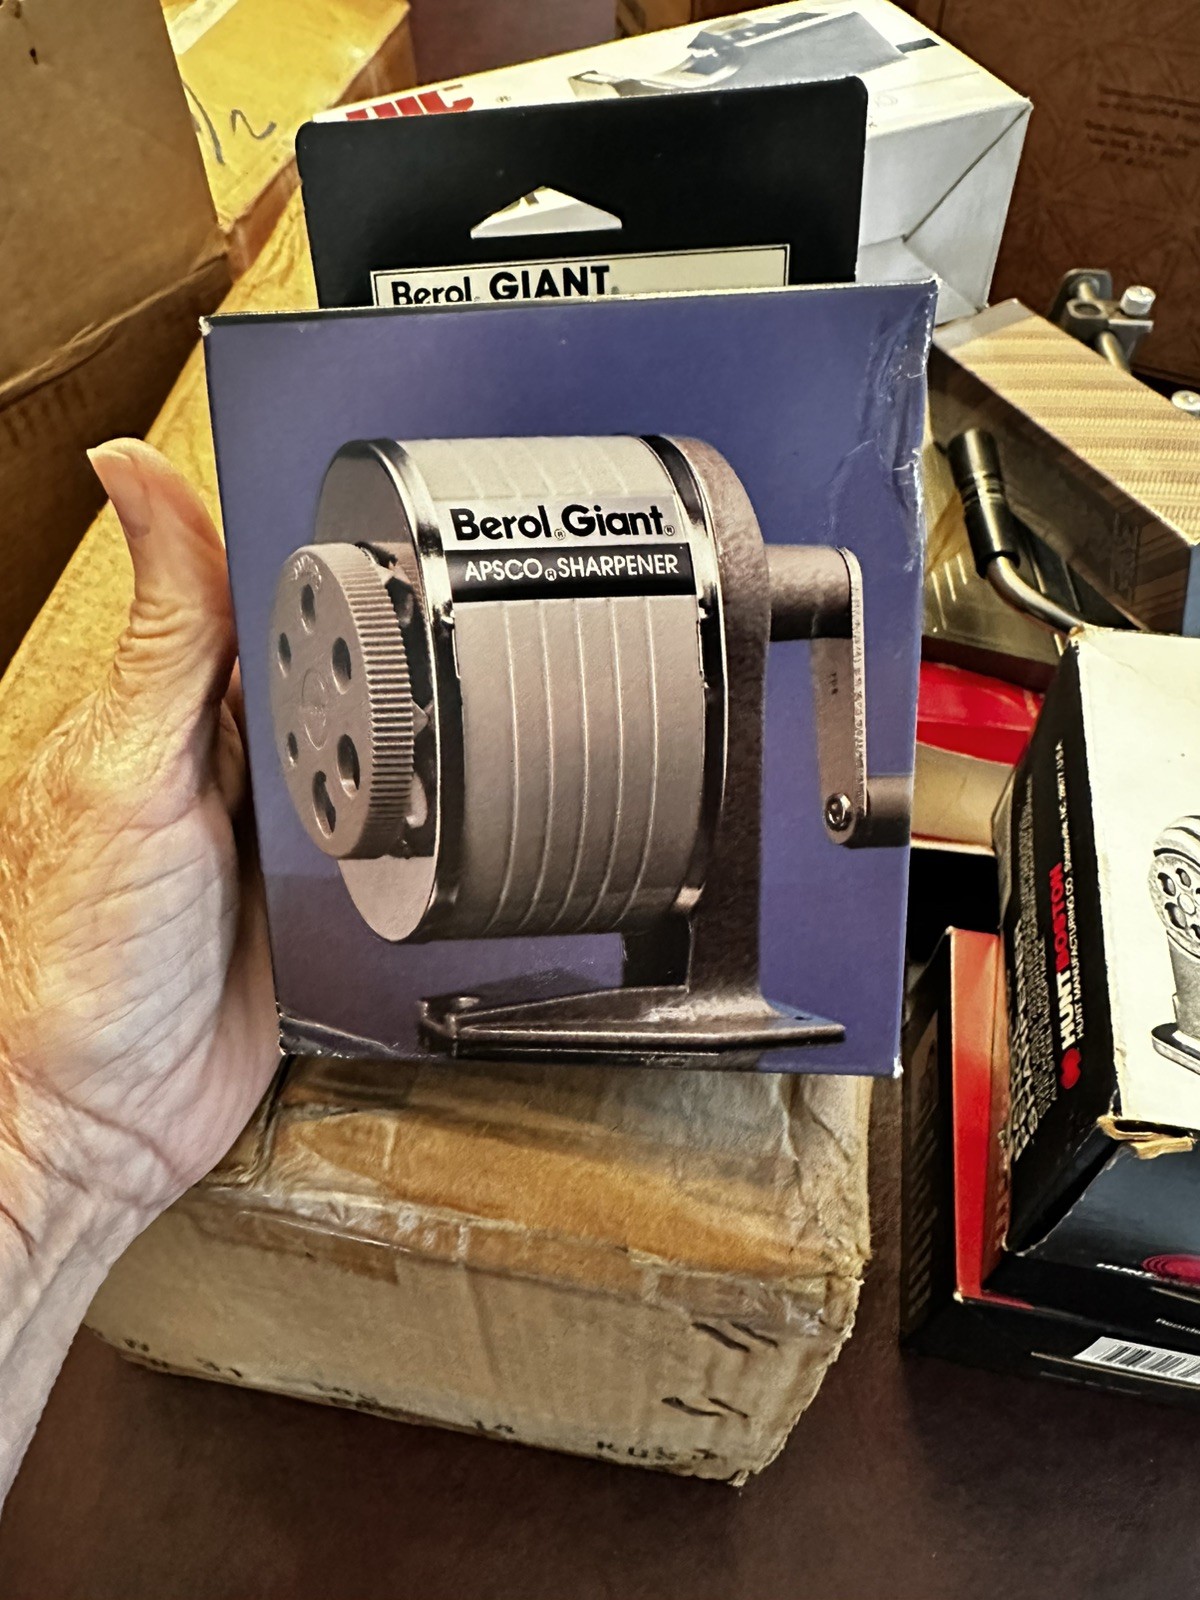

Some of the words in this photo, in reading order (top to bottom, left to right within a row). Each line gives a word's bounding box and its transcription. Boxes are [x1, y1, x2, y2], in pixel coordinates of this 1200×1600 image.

[391, 276, 473, 305] Berol
[489, 265, 610, 300] GIANT
[449, 504, 552, 541] Berol
[561, 503, 664, 537] Giant
[464, 557, 543, 582] APSCO
[557, 553, 680, 579] SHARPENER
[1066, 895, 1082, 1001] MANUFACTURING
[1056, 969, 1076, 1051] HUNT
[1075, 1001, 1085, 1040] HUNT
